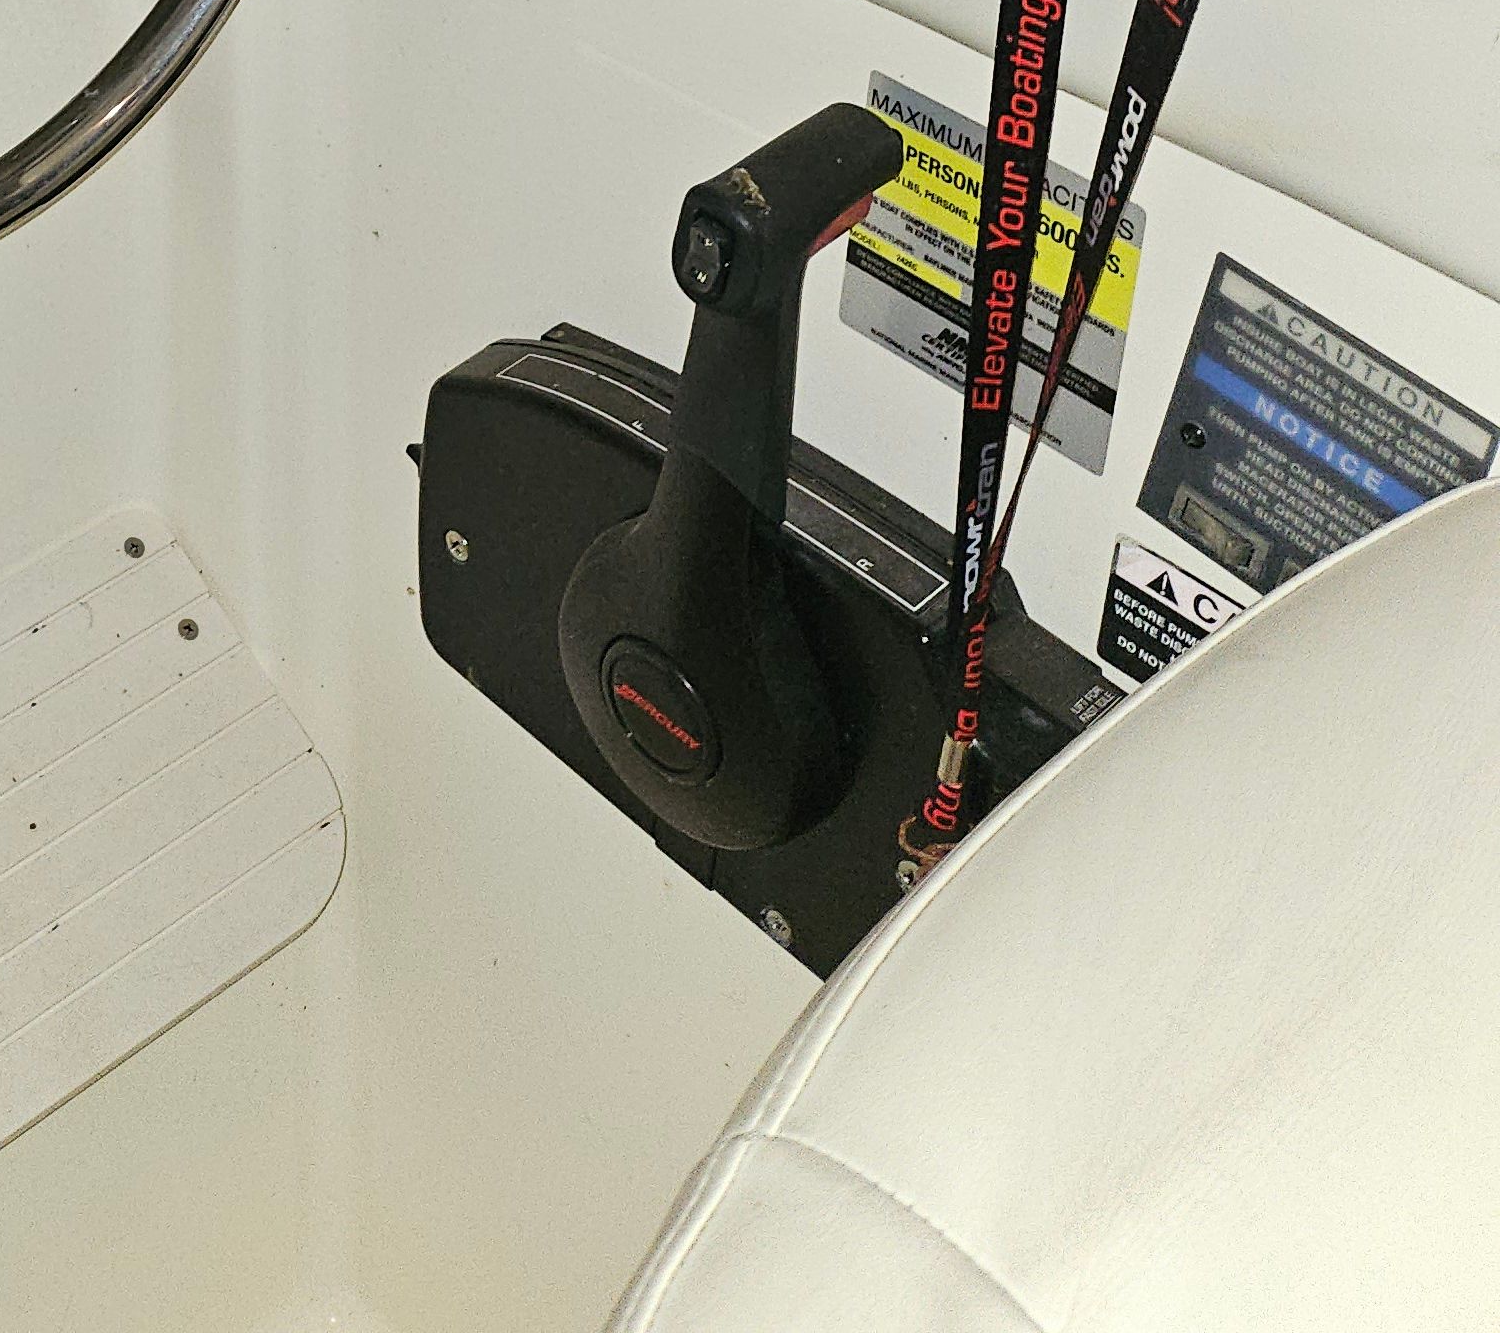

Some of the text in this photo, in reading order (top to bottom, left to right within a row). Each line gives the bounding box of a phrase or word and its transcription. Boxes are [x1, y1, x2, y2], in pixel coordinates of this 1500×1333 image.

[870, 87, 984, 163] MAXIMUM
[905, 144, 981, 201] PERSON
[924, 188, 972, 224] PERSONS,
[985, 160, 1030, 252] Your
[971, 267, 1018, 412] Elevate
[1224, 345, 1290, 392] PUMPING
[1288, 387, 1338, 424] AFTER
[1337, 419, 1375, 447] TANK
[1287, 316, 1444, 426] CAUTION
[631, 419, 645, 432] F
[1357, 396, 1406, 432] LEGAL
[1249, 395, 1390, 494] NOTICE
[1394, 437, 1469, 490] CONTINU
[855, 558, 875, 572] R
[1113, 587, 1166, 630] BEFORE
[1114, 602, 1160, 639] WASTE
[1116, 635, 1166, 672] DO NOT
[613, 683, 701, 750] MERCURY
